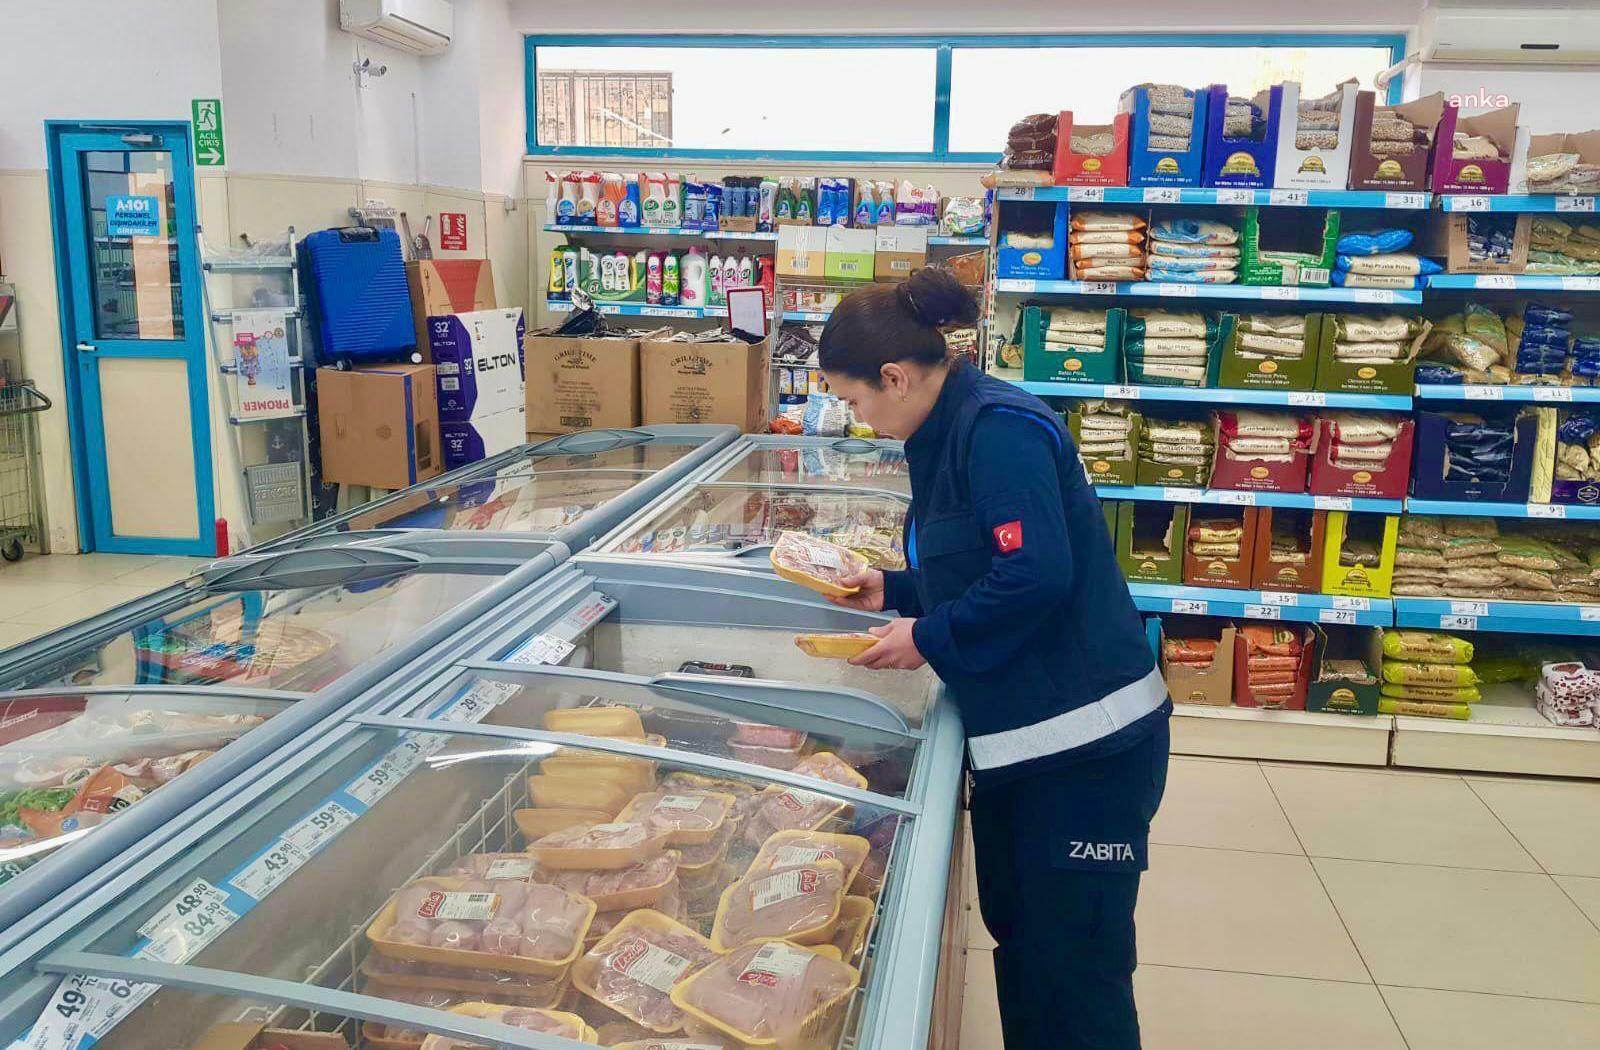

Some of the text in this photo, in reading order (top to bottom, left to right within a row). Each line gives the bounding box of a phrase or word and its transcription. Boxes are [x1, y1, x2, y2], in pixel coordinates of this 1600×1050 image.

[478, 352, 516, 372] ELTON
[244, 398, 289, 412] PROMER
[310, 804, 341, 830] 59,90
[264, 843, 293, 872] 43,90
[1069, 841, 1135, 861] ZABITA
[176, 883, 208, 917] 48,90
[184, 902, 220, 937] 84,50
